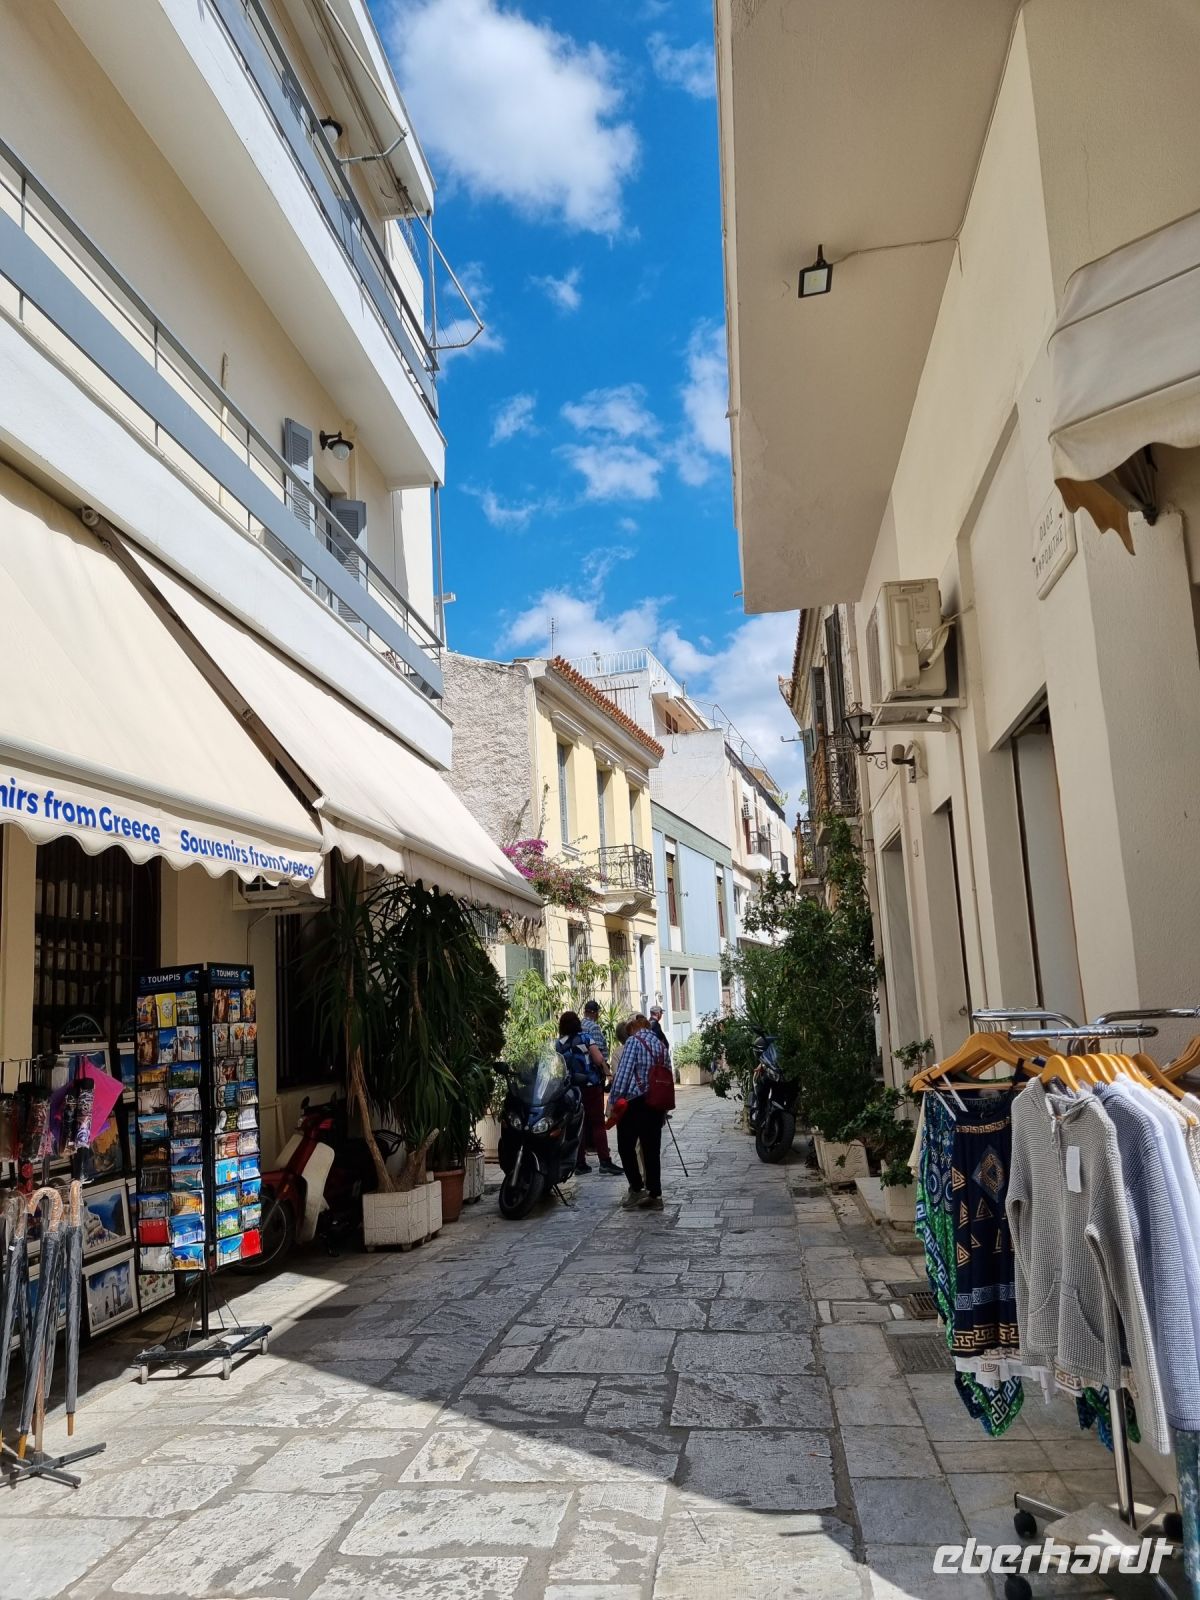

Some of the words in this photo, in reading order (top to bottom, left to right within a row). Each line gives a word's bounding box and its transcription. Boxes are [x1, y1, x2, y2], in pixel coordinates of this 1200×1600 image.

[43, 790, 97, 829] from
[99, 806, 161, 844] Greece
[180, 829, 249, 864] Souvenirs
[249, 845, 281, 870] from
[279, 855, 315, 879] Greece
[147, 973, 181, 984] TOUMPIS
[216, 969, 240, 978] TOUMPIS
